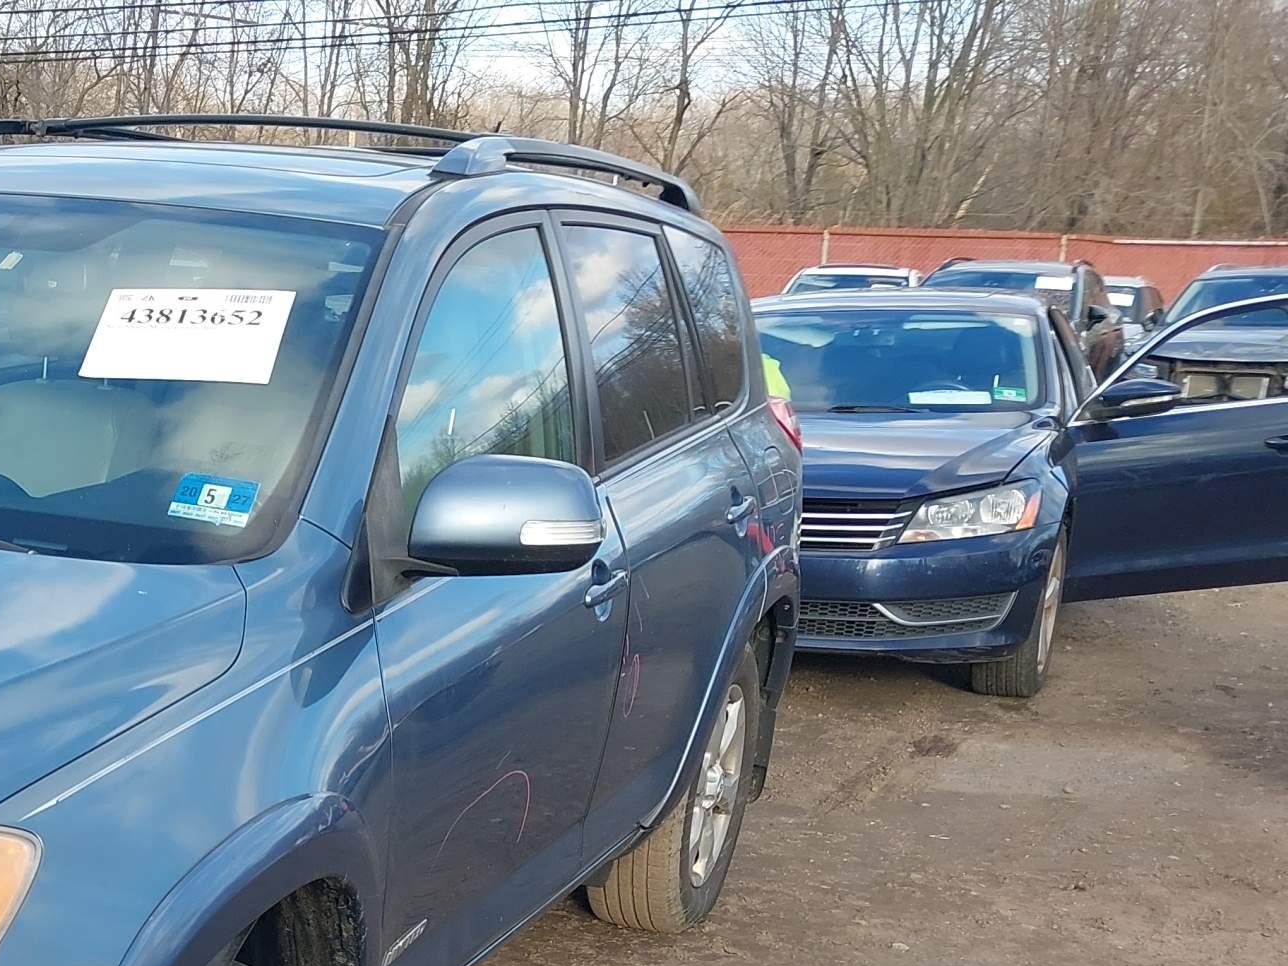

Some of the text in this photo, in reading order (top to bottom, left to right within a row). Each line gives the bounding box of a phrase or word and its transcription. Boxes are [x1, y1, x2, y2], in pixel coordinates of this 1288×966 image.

[119, 307, 263, 326] 43813652
[180, 486, 250, 505] 20 5 27
